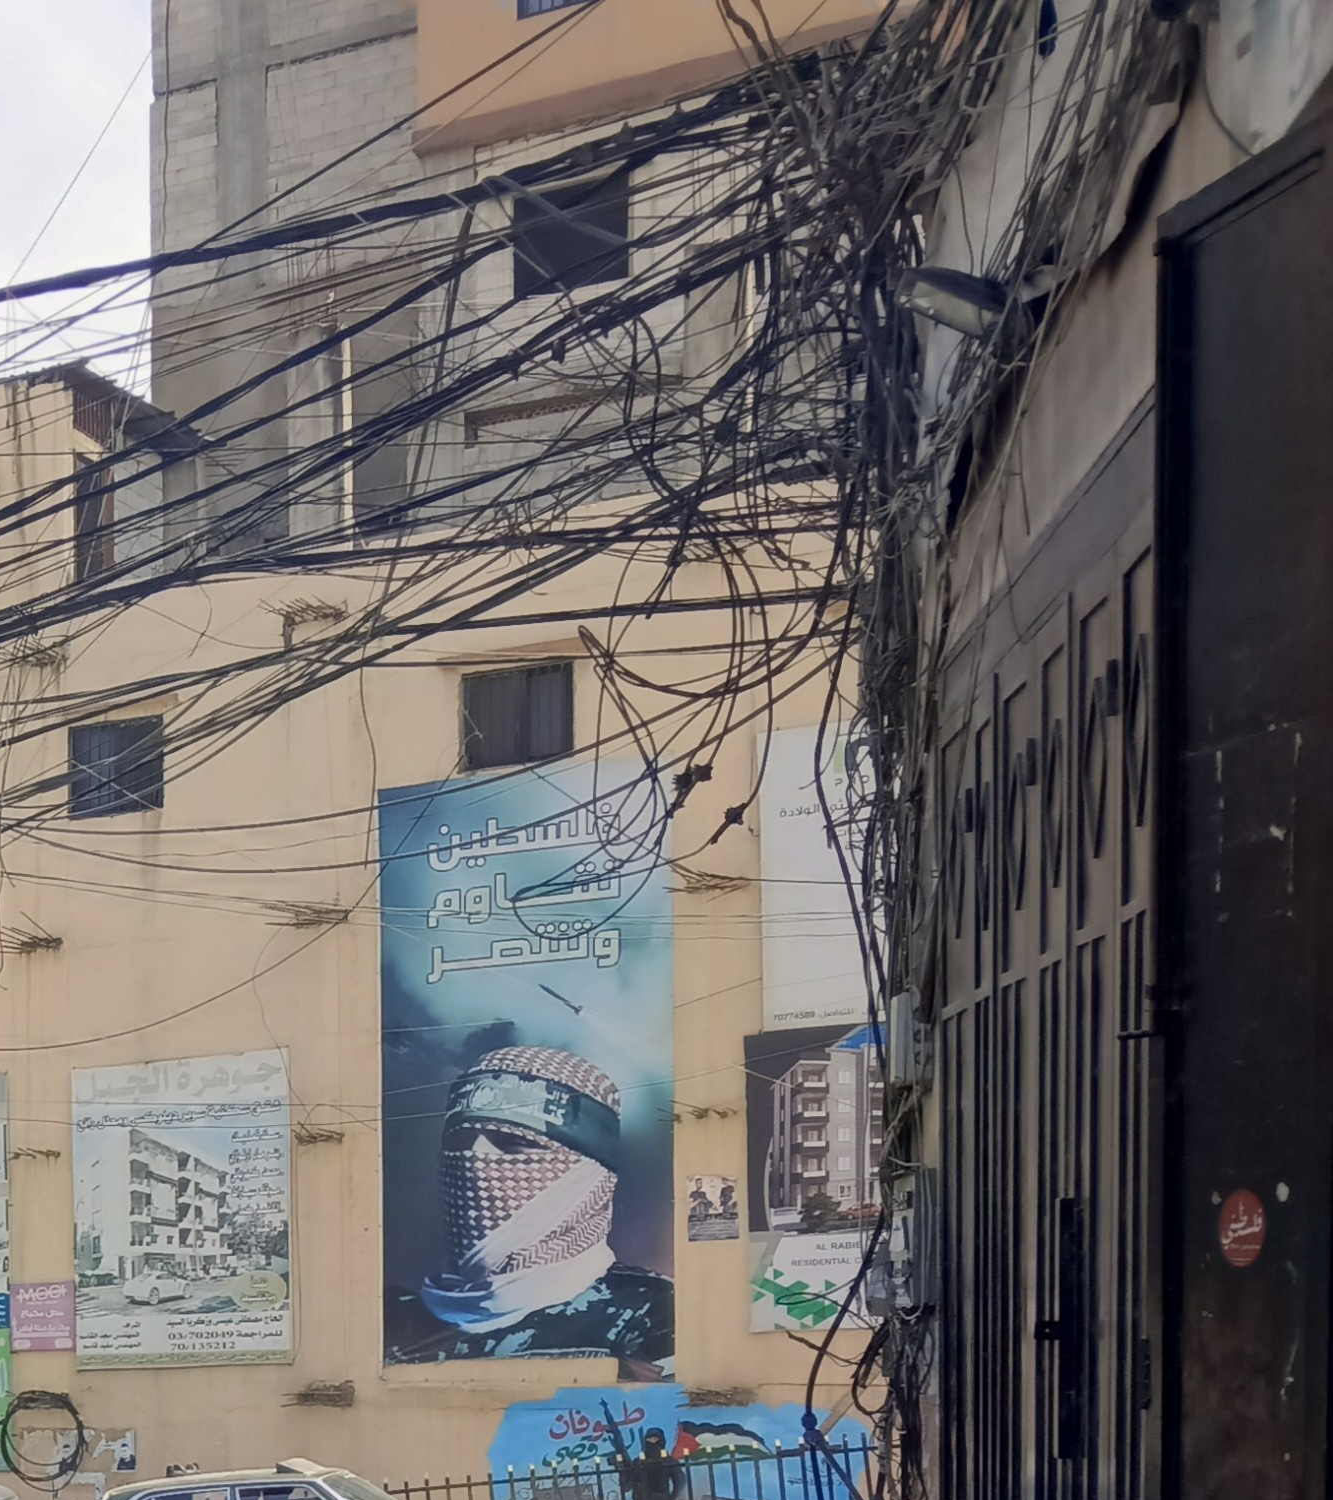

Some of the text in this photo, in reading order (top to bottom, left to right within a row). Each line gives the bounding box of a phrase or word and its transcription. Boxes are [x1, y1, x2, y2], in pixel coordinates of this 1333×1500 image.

[177, 1061, 282, 1097] جوهرة
[791, 1257, 851, 1267] RESIDENTIAL
[549, 1400, 646, 1441] طوفان
